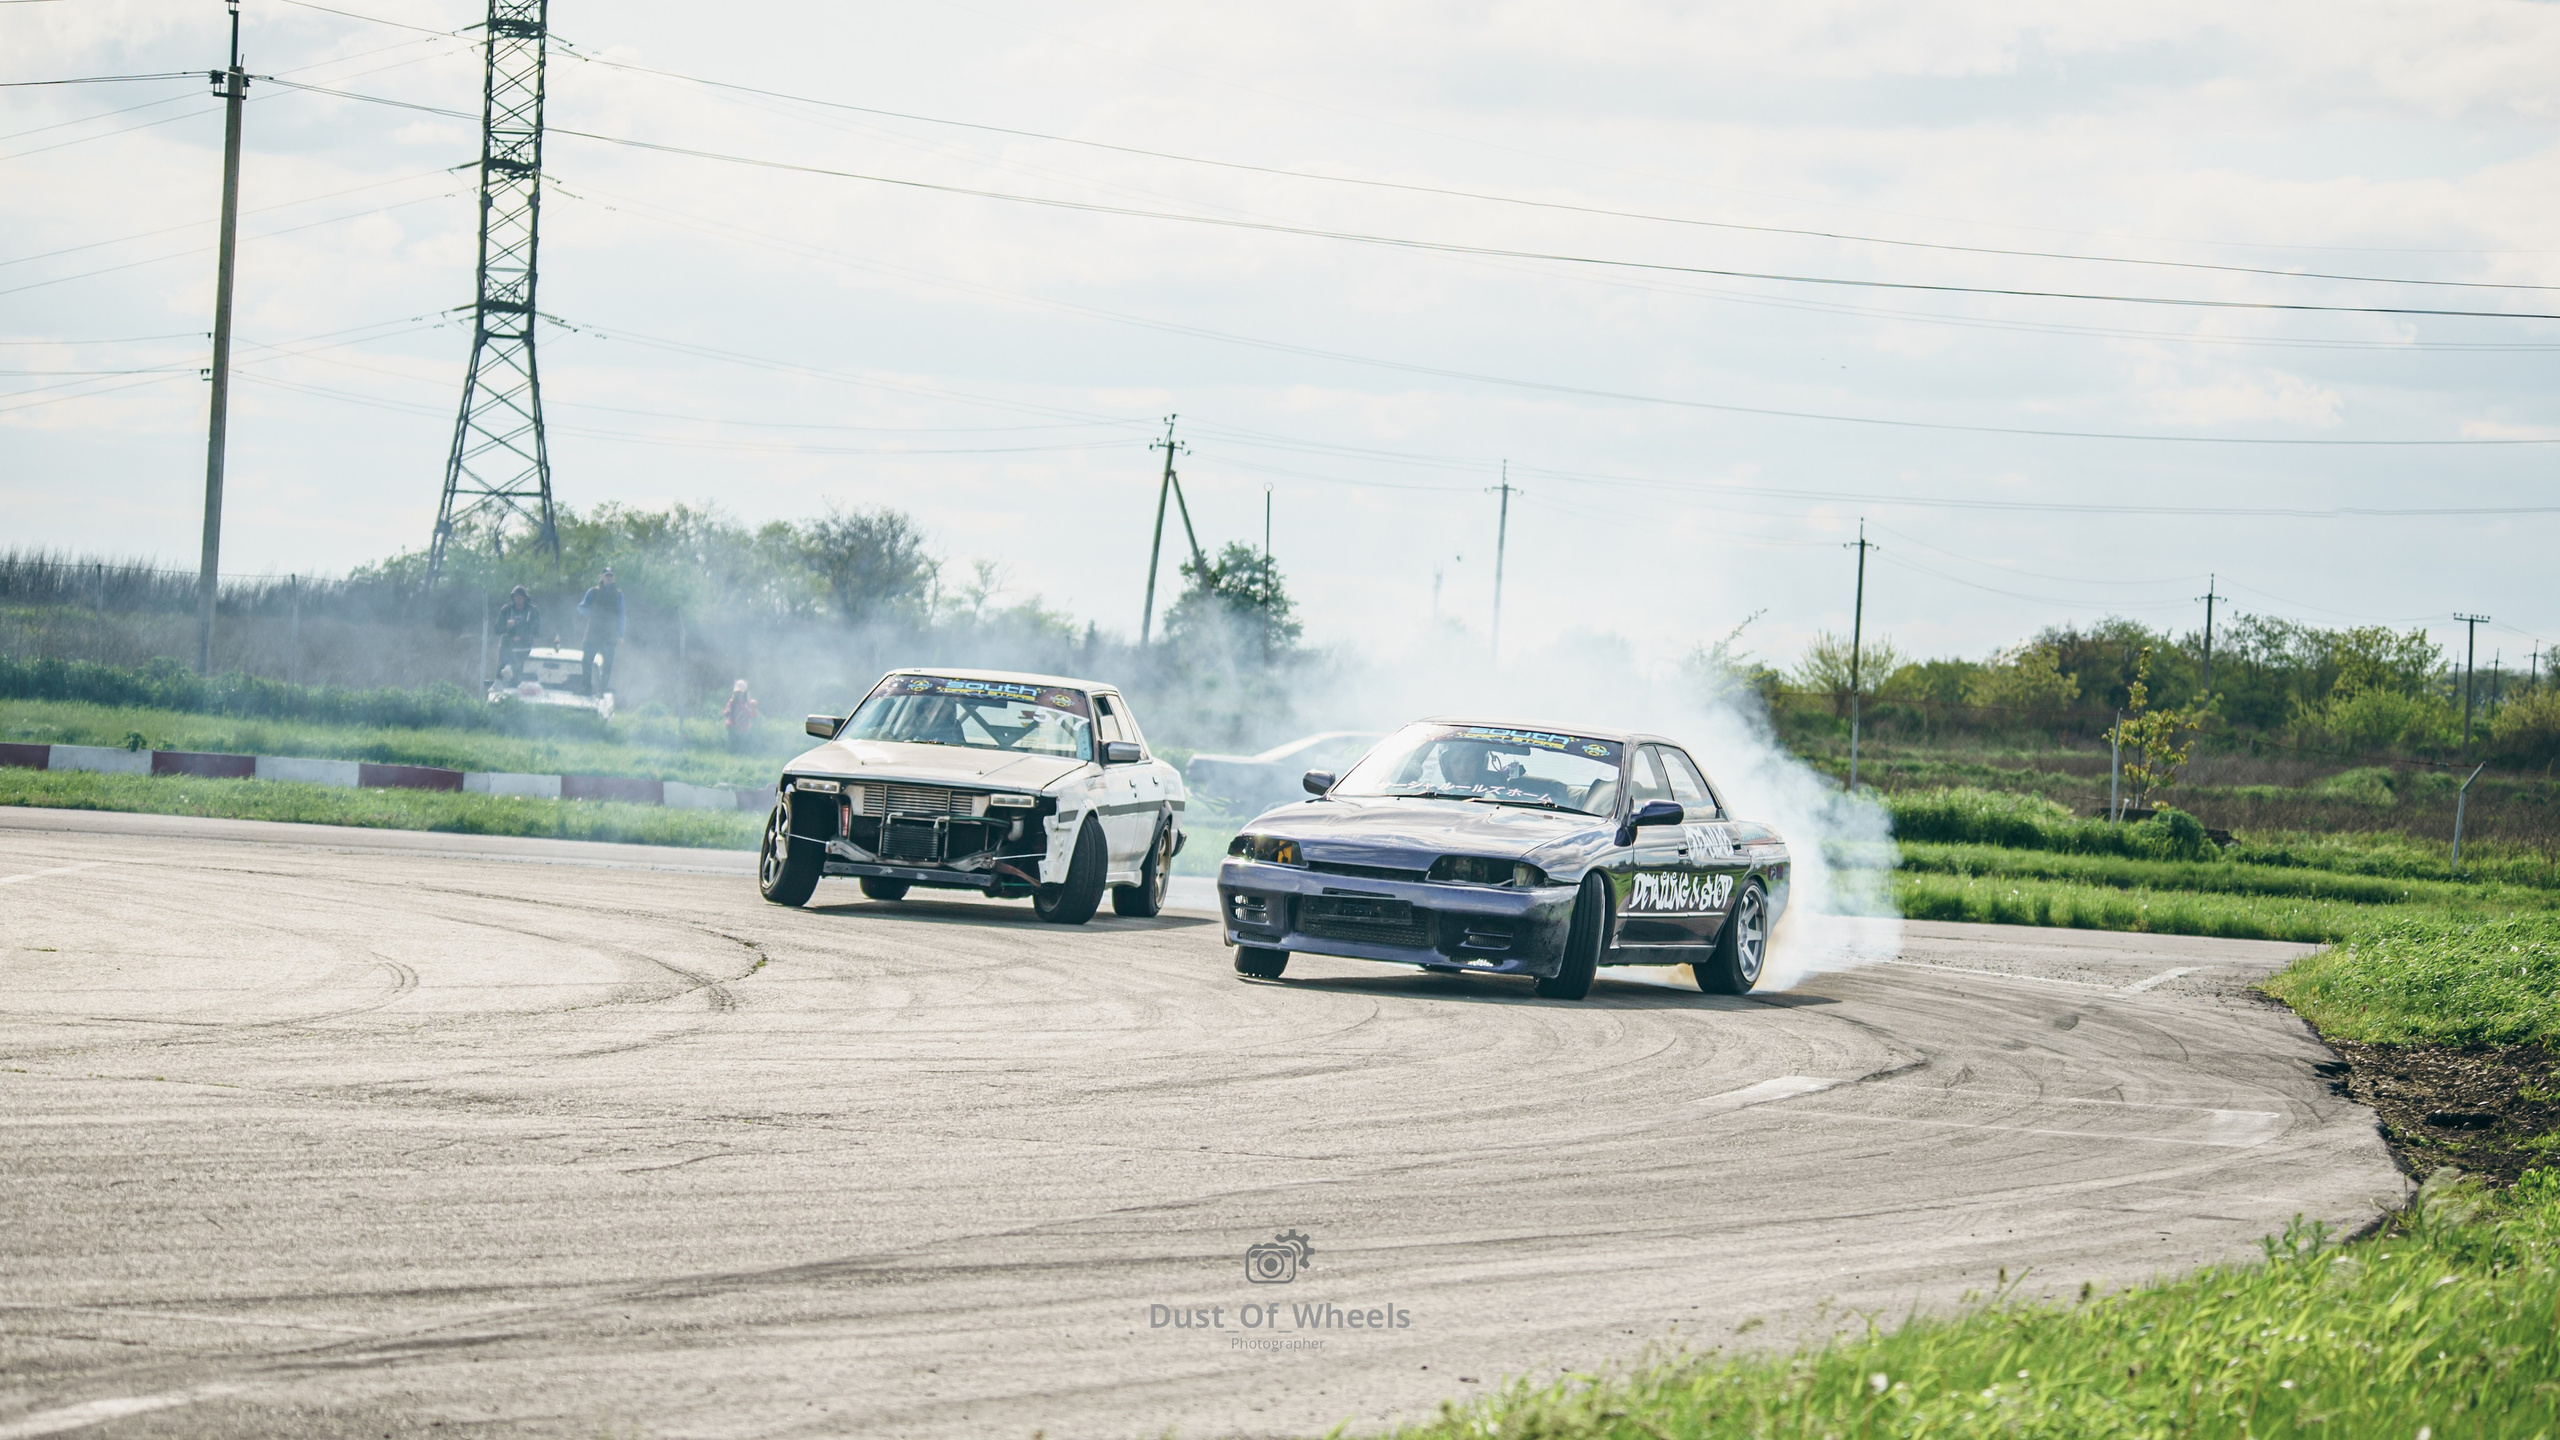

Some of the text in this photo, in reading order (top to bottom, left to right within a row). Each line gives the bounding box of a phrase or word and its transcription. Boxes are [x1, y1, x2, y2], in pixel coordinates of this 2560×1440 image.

[1033, 706, 1090, 731] 577
[1689, 876, 1701, 910] &
[1699, 874, 1734, 911] SHOP
